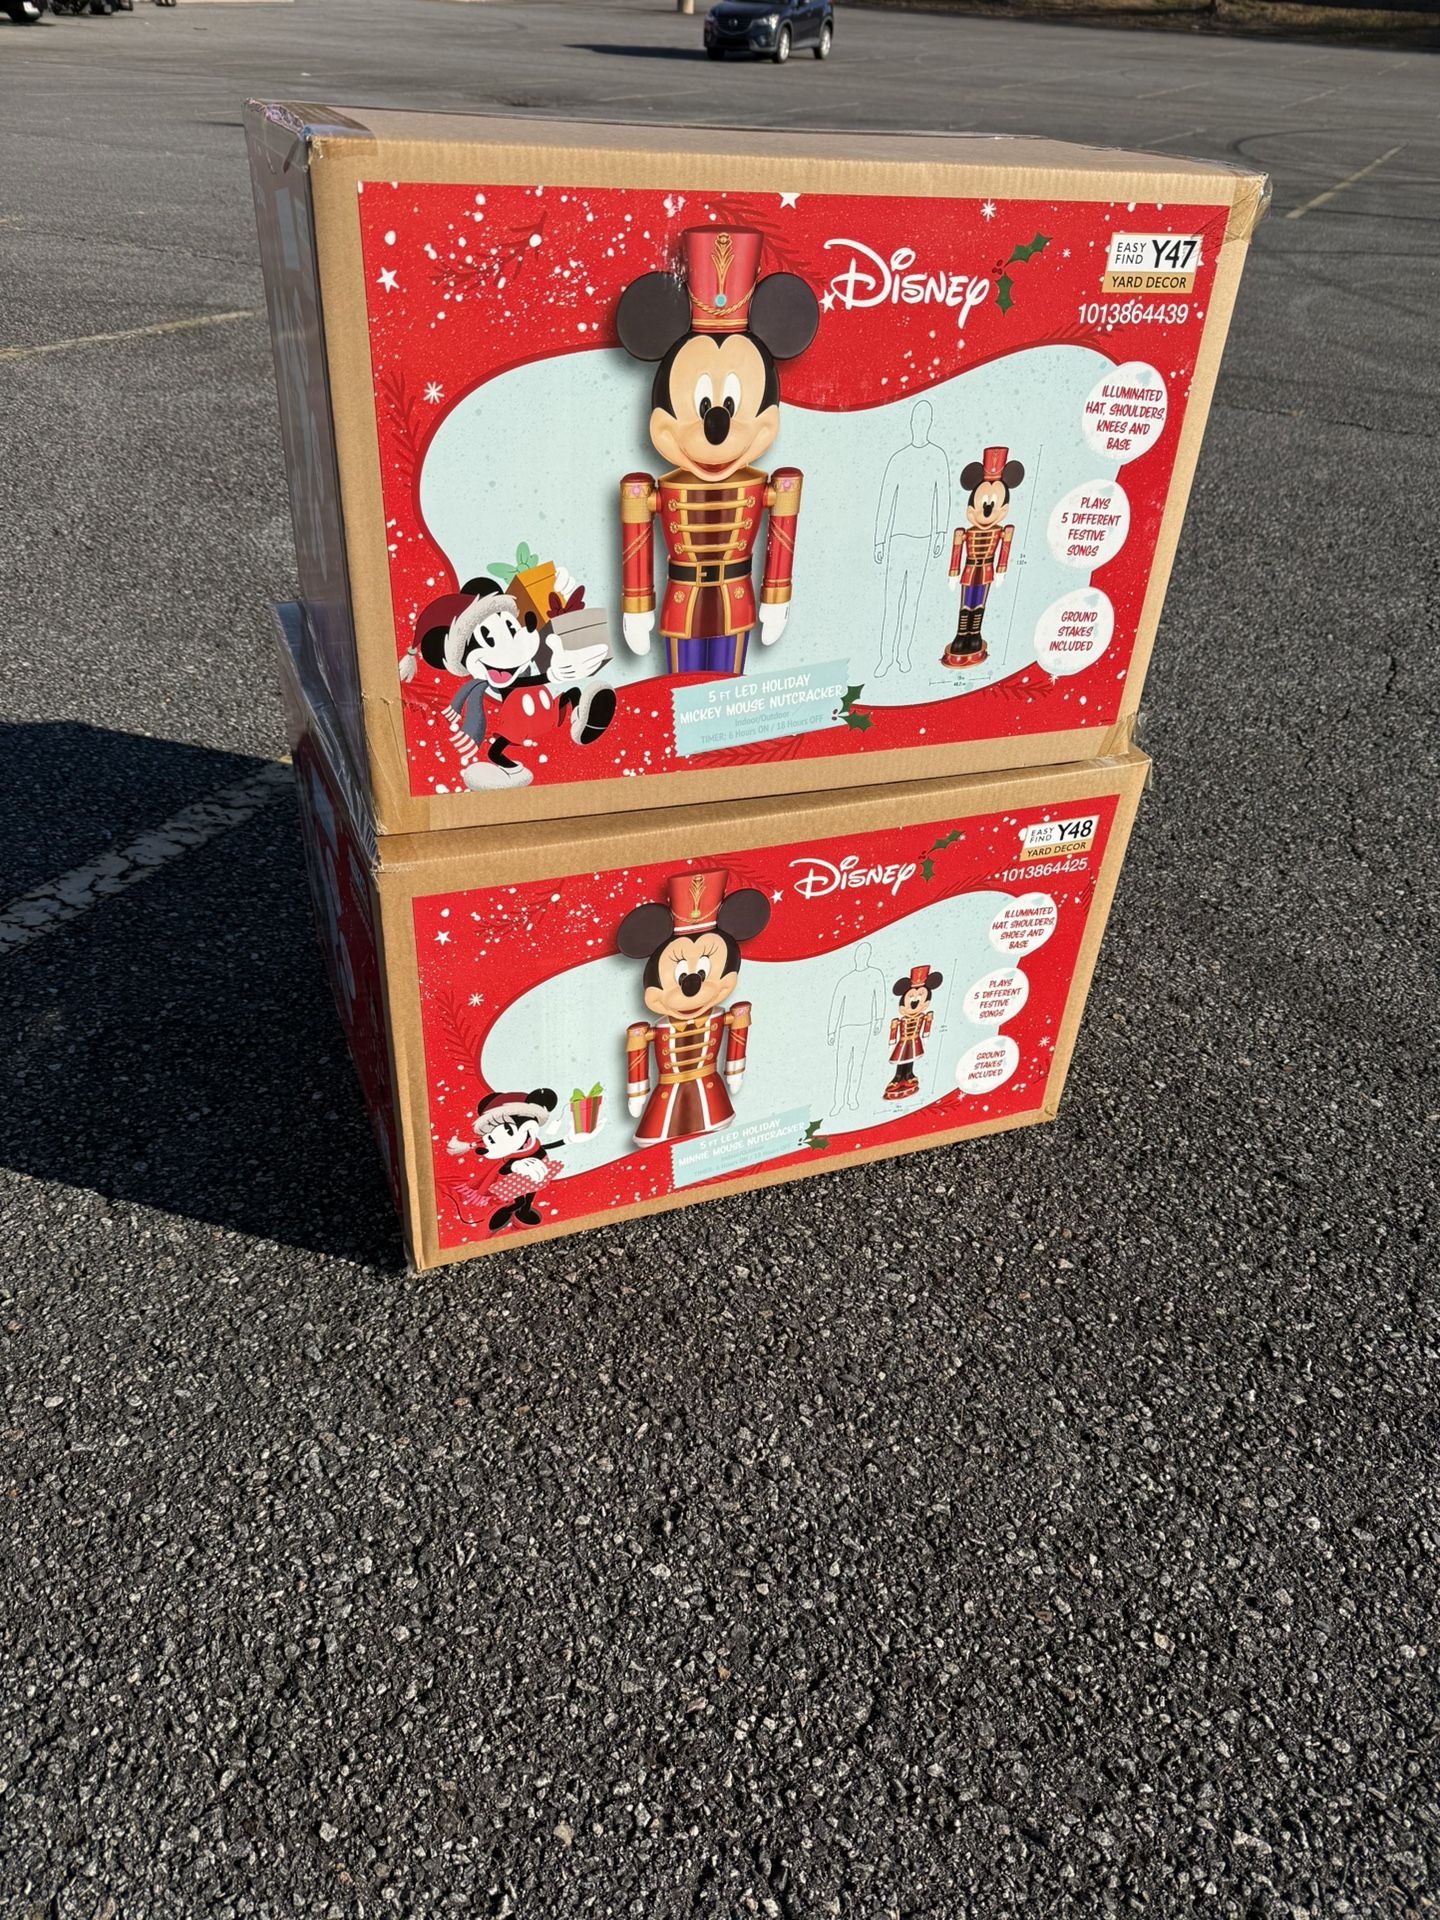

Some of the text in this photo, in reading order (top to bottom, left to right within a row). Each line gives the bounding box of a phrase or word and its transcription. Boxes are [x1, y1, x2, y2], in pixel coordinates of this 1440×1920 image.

[1116, 242, 1147, 253] EASY
[1152, 239, 1198, 269] Y47
[1114, 254, 1144, 265] FIND
[1112, 276, 1187, 289] YARD DECOR
[1078, 303, 1189, 325] 1013864439
[1101, 385, 1163, 402] ILLUMINATED
[1109, 403, 1165, 421] SHOULDERS,
[1096, 419, 1150, 435] KNEES AND
[1106, 437, 1132, 451] BASE
[1080, 497, 1111, 510] PLAYS
[1061, 512, 1122, 527] 5 DIFFERENT
[1068, 529, 1106, 541] FESTIVE
[1067, 544, 1099, 557] SONGS
[1061, 611, 1098, 622] GROUND
[1057, 626, 1093, 637] STAKES
[1049, 641, 1093, 652] INCLUDED
[708, 690, 716, 703] 5
[735, 684, 758, 698] LED
[762, 673, 811, 694] HOLIDAY
[679, 684, 843, 725] MICKEY MOUSE NUTCRACKER
[735, 710, 790, 727] Indoor/Outdoor
[735, 726, 757, 739] Hours
[758, 723, 769, 734] ON
[787, 717, 809, 730] Hours
[1031, 827, 1055, 837] EASY
[1058, 819, 1094, 841] Y48
[1029, 835, 1052, 844] FIND
[1027, 841, 1087, 858] YARD DECOR
[1001, 857, 1089, 883] 1013864425
[1004, 906, 1053, 918] ILLUMINATED
[1000, 928, 1045, 940] SHOES AND
[1008, 940, 1029, 950] BASE
[989, 979, 1013, 988] PLAYS
[974, 988, 1022, 1000] 5 DIFFERENT
[979, 998, 1010, 1009] FESTIVE
[979, 1009, 1005, 1019] SONGS
[976, 1050, 1006, 1061] GROUND
[974, 1060, 1003, 1070] STAKES
[967, 1069, 1003, 1080] INCLUDED
[720, 1131, 740, 1144] LED
[742, 1119, 781, 1138] HOLIDAY
[678, 1152, 710, 1167] MINNIE
[713, 1142, 745, 1156] MOUSE
[747, 1122, 805, 1147] NUTCRACKER
